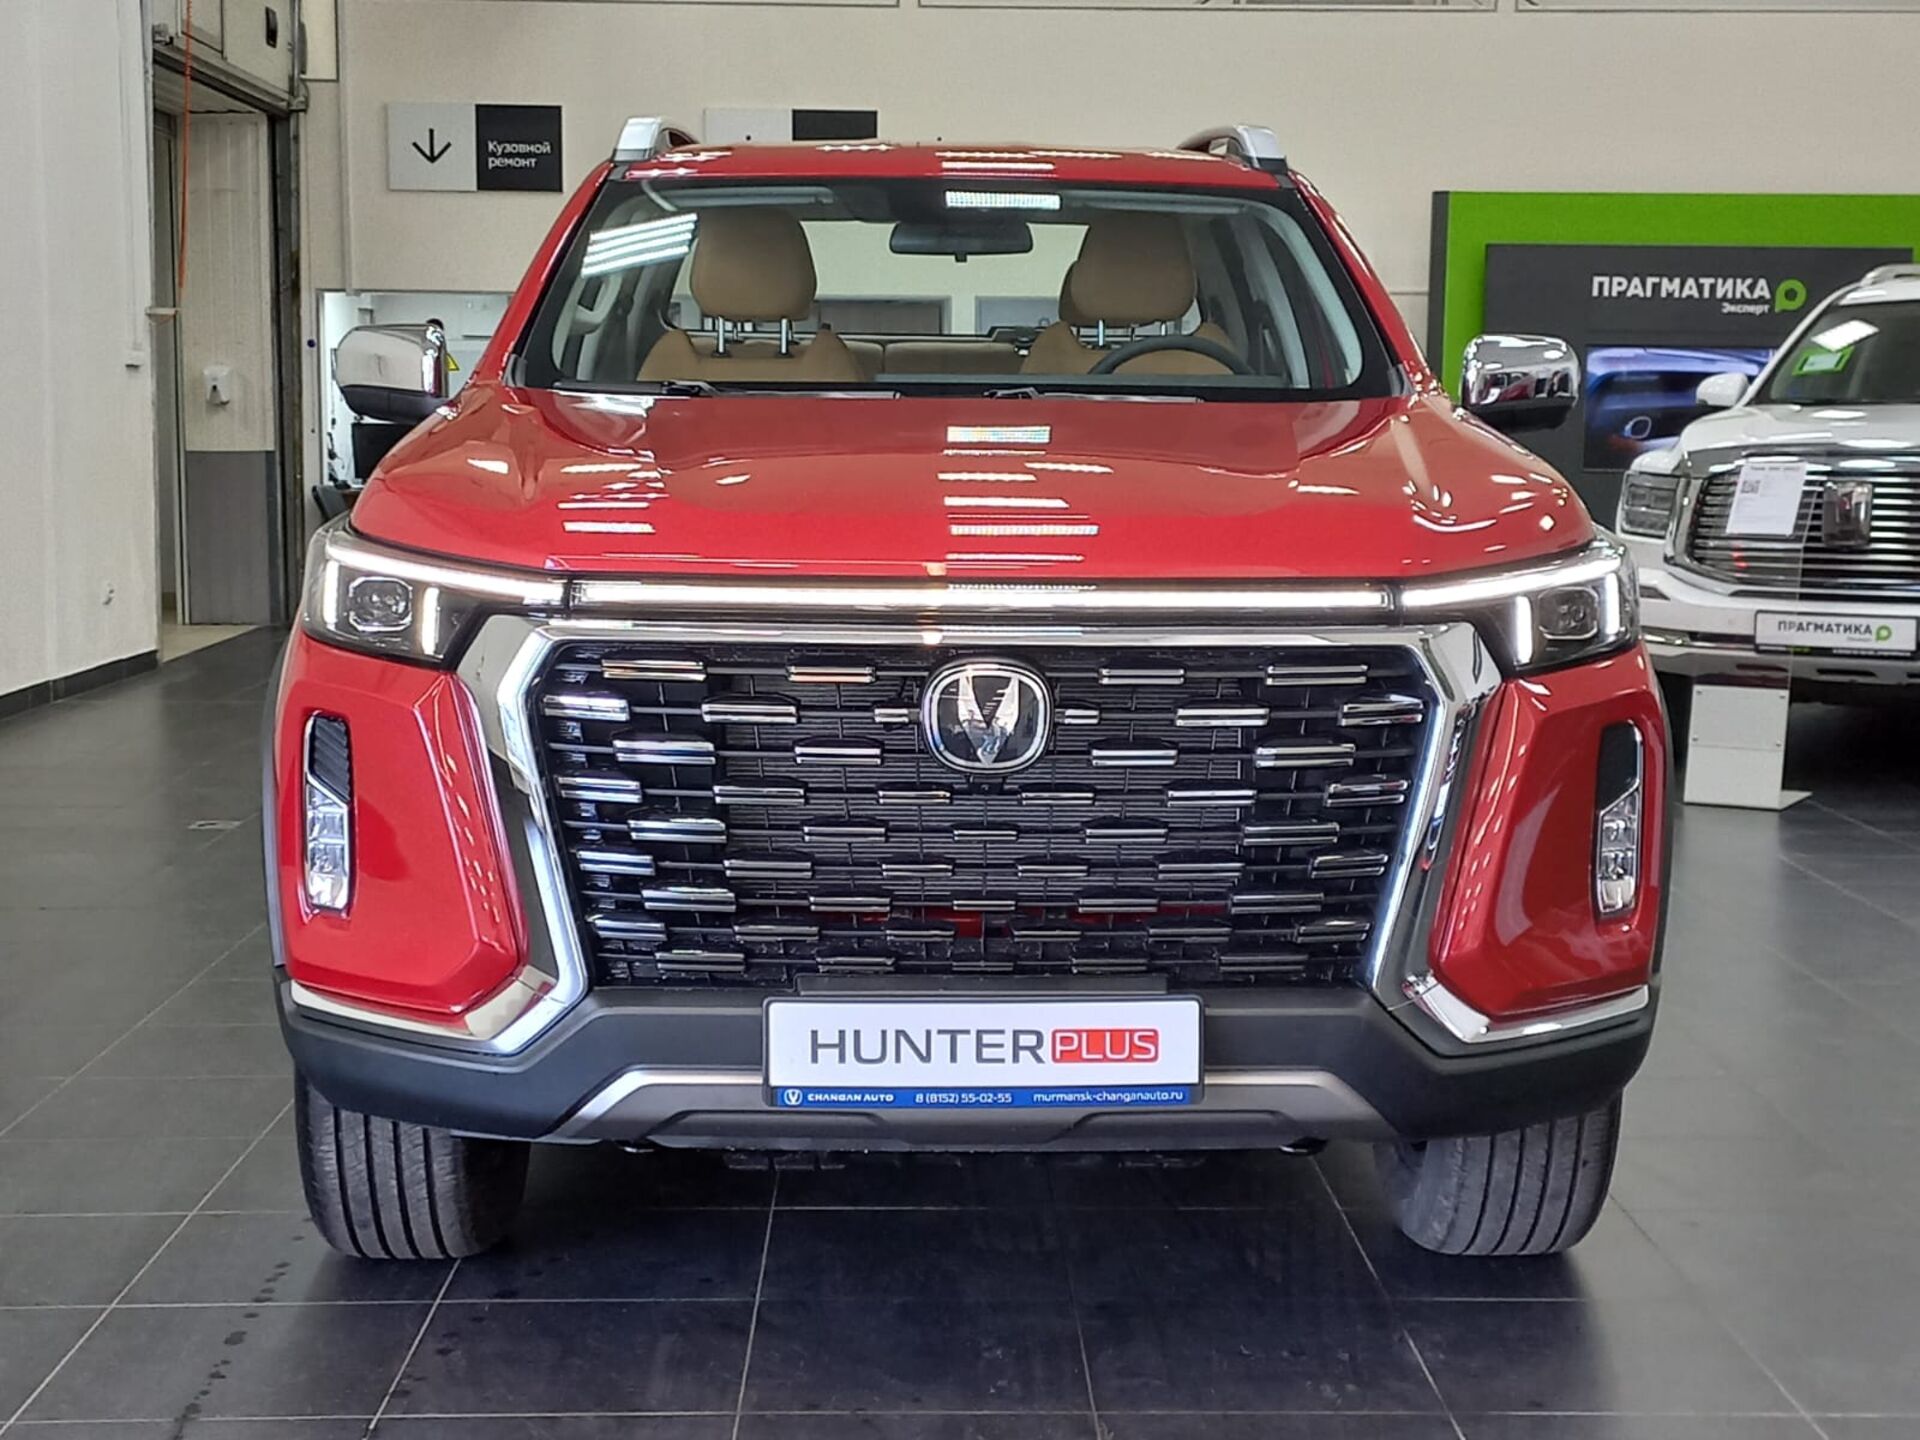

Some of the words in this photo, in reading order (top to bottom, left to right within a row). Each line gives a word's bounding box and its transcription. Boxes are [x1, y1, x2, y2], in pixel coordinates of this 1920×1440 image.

[488, 141, 551, 156] Кузовной
[488, 157, 537, 170] ремонт
[1592, 276, 1771, 299] ПРАГМАТИКА
[1722, 303, 1769, 315] Эксперт
[1778, 620, 1873, 636] ПРАГМАТИКА
[810, 1029, 1045, 1064] HUNTER
[1055, 1031, 1157, 1060] PLUS
[807, 1093, 862, 1103] CHANGAN
[863, 1093, 895, 1103] AUTO
[915, 1092, 924, 1103] 8
[926, 1092, 960, 1104] (8152)
[961, 1092, 1012, 1103] 55-02-55
[1033, 1091, 1184, 1104] murmansk-changanauto.ru
